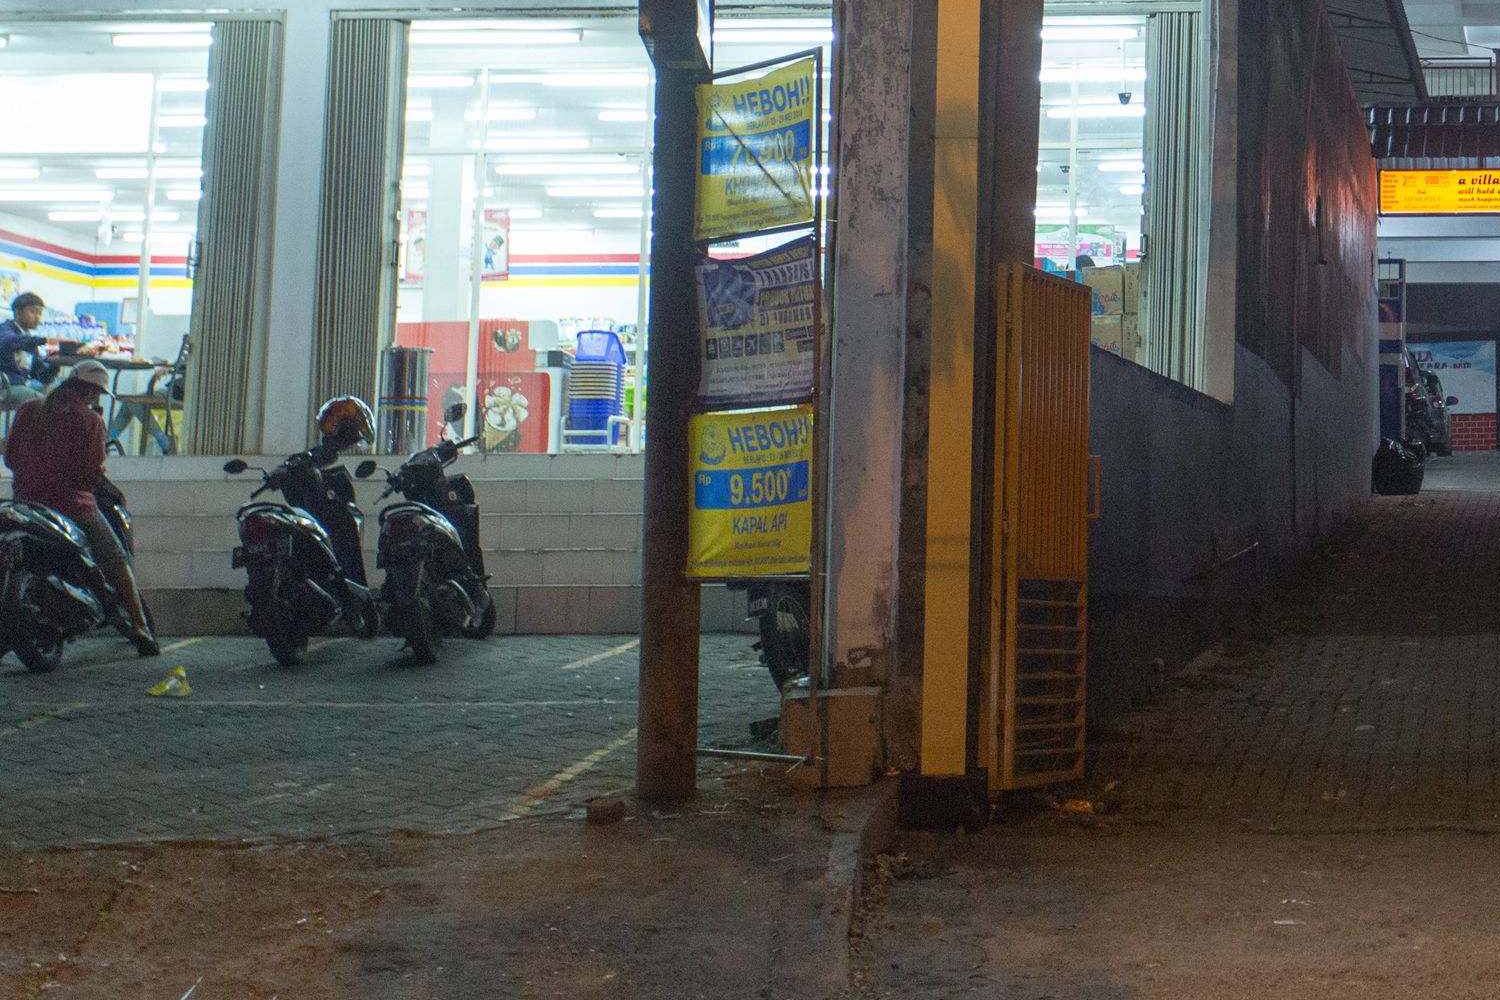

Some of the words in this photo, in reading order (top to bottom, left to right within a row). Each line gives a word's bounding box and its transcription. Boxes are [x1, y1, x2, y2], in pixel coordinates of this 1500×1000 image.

[732, 76, 811, 118] HEBOH!!
[727, 415, 809, 454] HEBOH!!
[732, 516, 768, 536] KAPAL
[771, 513, 788, 533] API
